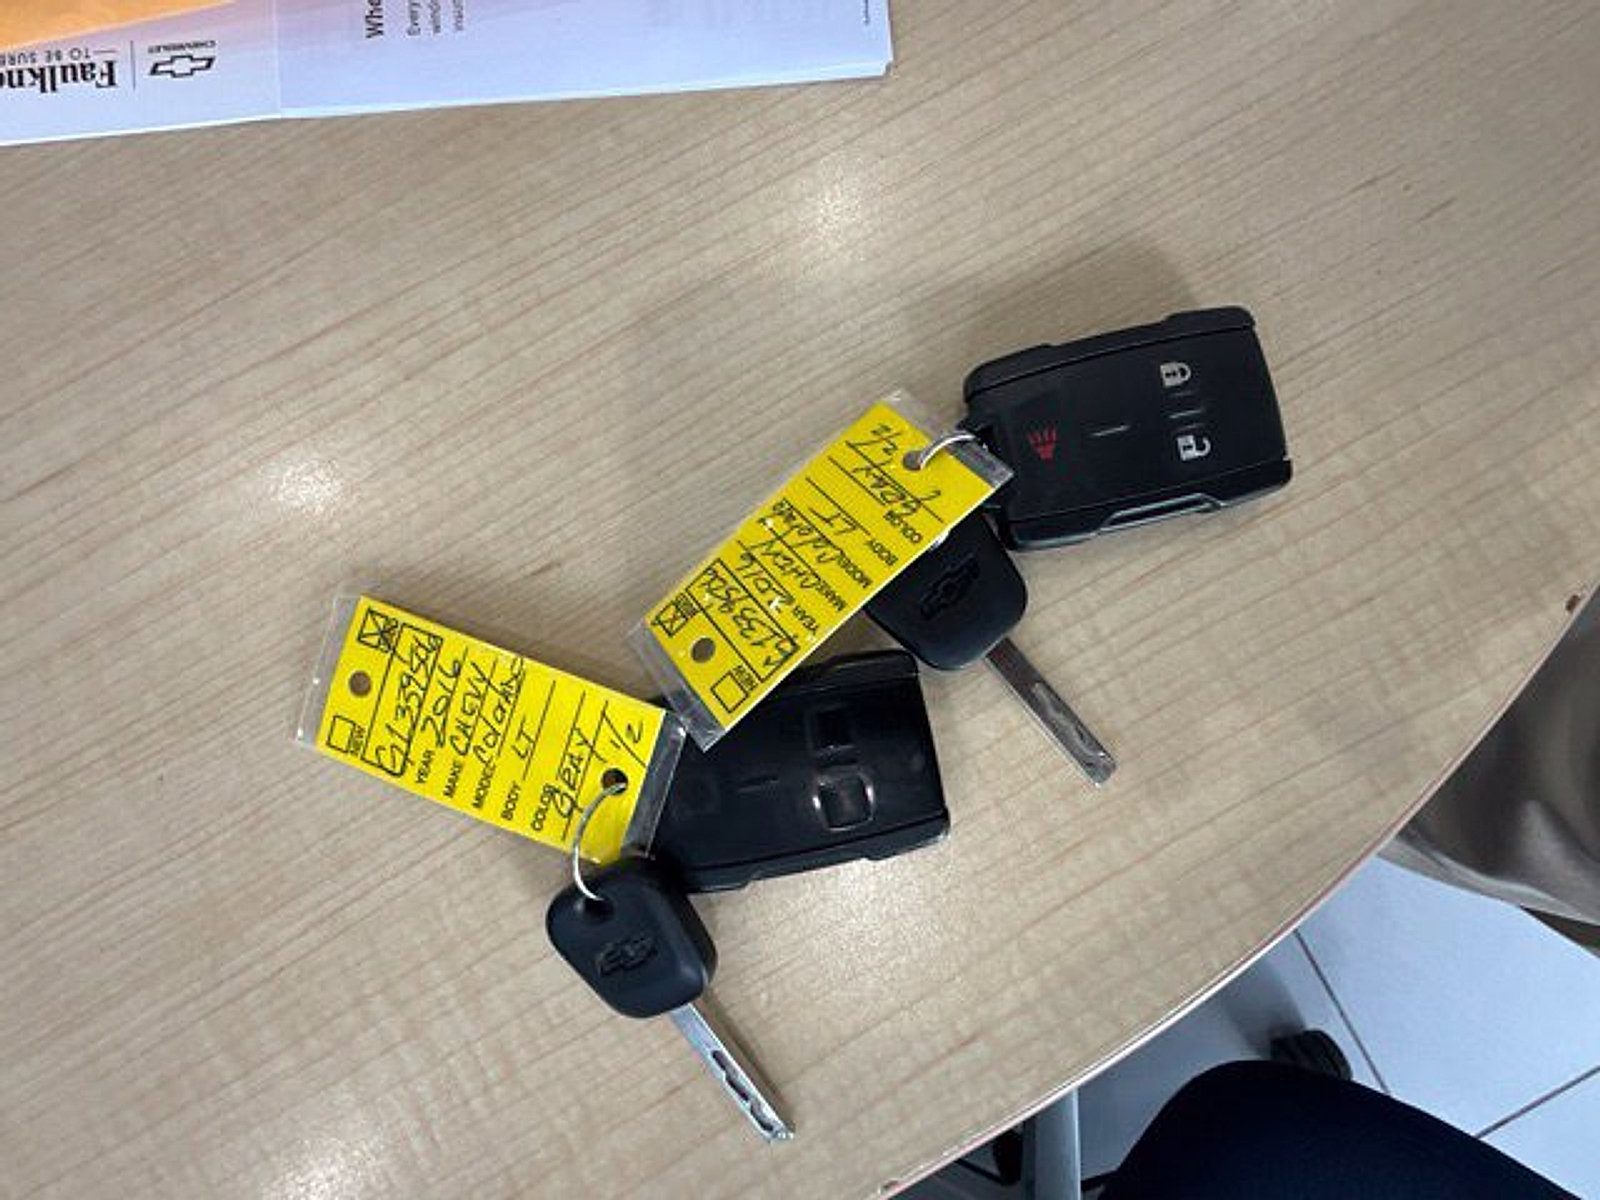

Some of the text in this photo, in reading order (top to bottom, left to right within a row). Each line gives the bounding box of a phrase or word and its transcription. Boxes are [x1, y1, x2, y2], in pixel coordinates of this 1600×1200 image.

[44, 50, 62, 62] BE
[70, 47, 91, 60] TO
[148, 40, 216, 54] CHEVROLET
[808, 508, 898, 566] BODY LT
[884, 510, 922, 543] COLOR
[837, 553, 872, 588] MODEL
[815, 580, 846, 611] MAKE
[792, 606, 818, 635] YEAR
[416, 660, 460, 783] YEAR 2016
[443, 760, 463, 798] MAKE
[501, 714, 535, 820] BODY LT
[472, 762, 496, 808] MODEL
[531, 784, 556, 831] COLOR
